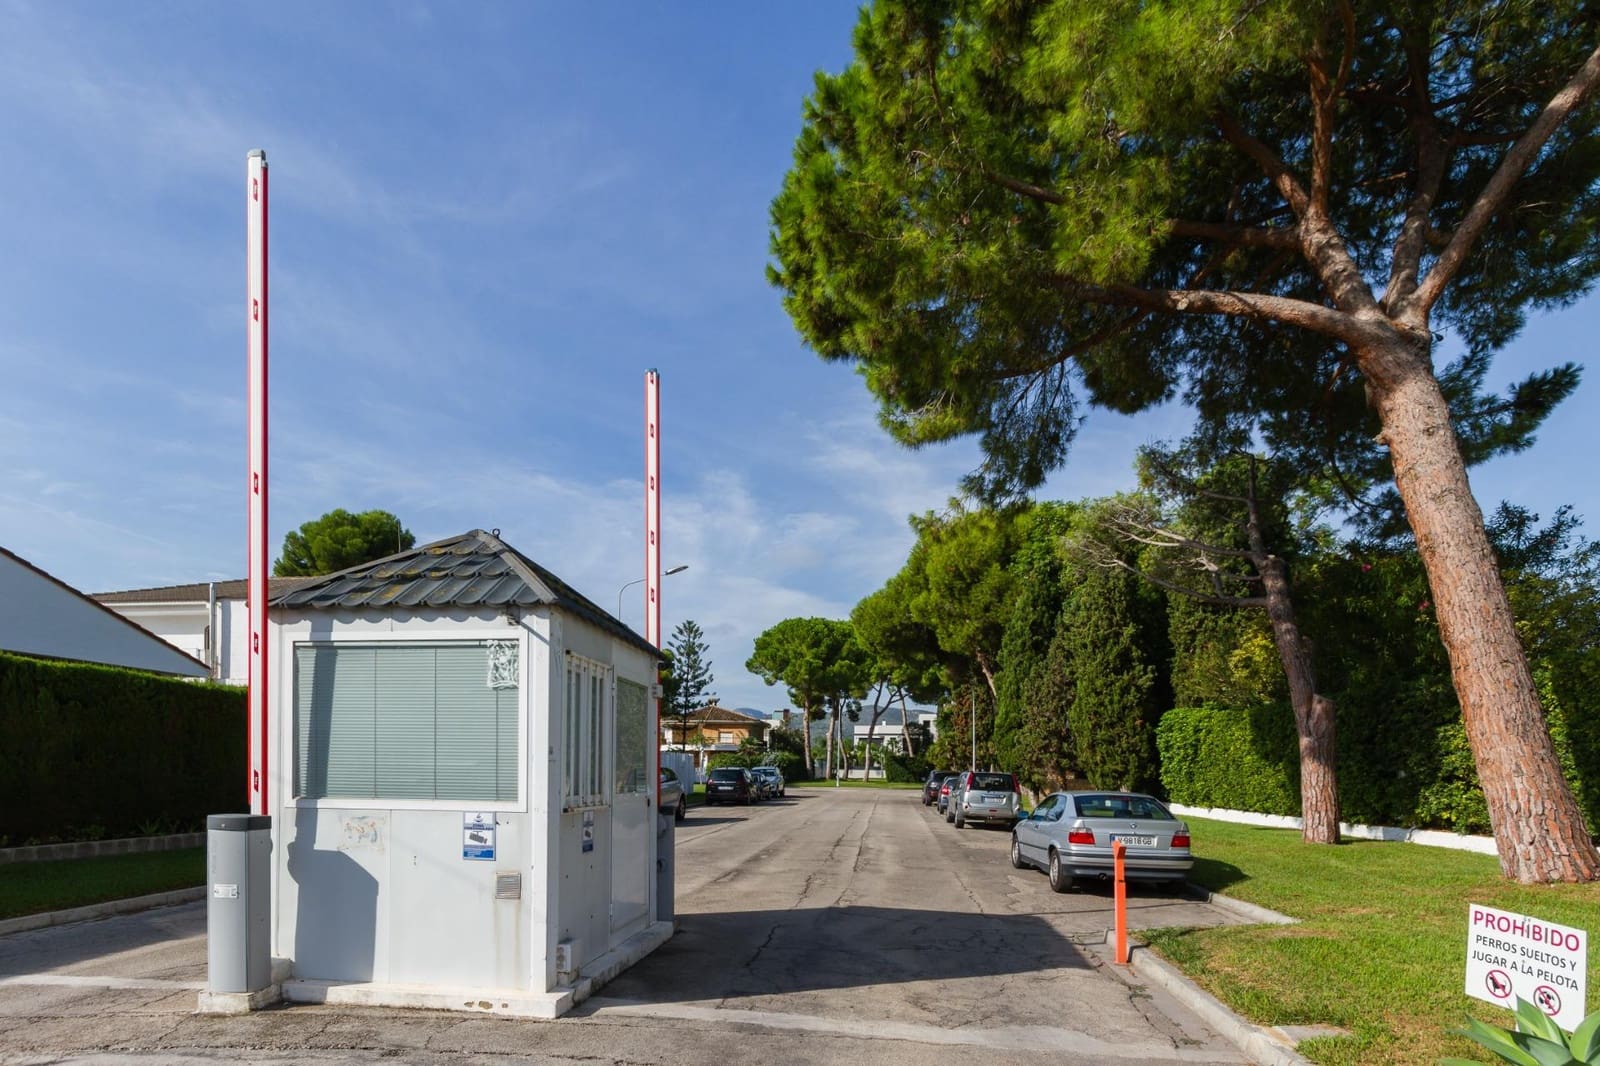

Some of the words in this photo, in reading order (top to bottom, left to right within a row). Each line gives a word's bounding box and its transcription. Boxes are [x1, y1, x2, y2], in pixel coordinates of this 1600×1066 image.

[1473, 910, 1580, 952] PROHIBIDO
[1472, 950, 1507, 969] JUGAR
[1510, 961, 1518, 972] A
[1521, 964, 1534, 977] LA
[1536, 968, 1579, 991] PELOTA
[1475, 934, 1517, 954] PERROS
[1520, 946, 1567, 969] SUELTOS
[1569, 960, 1577, 972] Y
